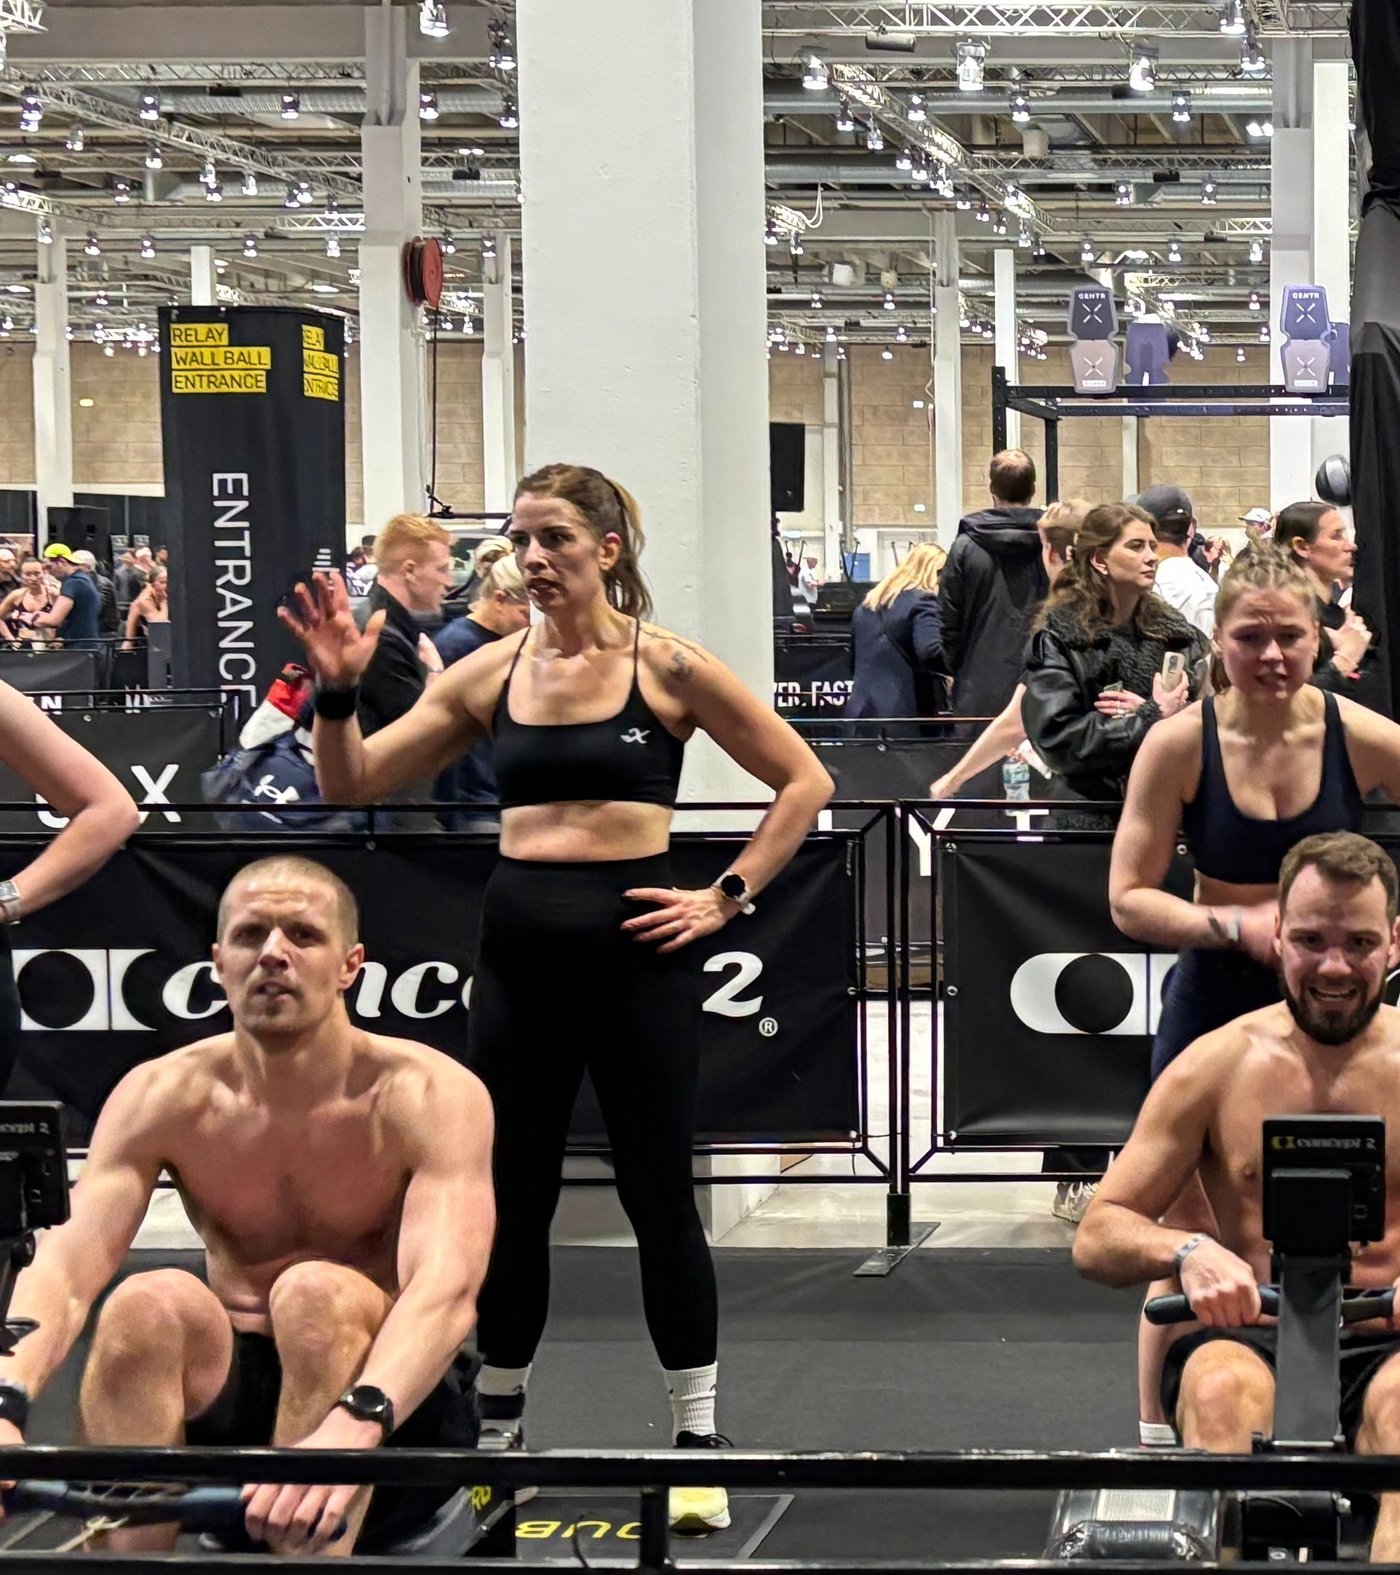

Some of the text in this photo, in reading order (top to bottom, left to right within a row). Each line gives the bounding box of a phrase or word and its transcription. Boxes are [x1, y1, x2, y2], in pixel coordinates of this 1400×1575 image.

[172, 327, 225, 342] RELAY
[174, 350, 268, 366] WALL BALL
[174, 373, 265, 389] ENTRANCE
[212, 472, 257, 718] ENTRANCE
[702, 951, 764, 1018] 2
